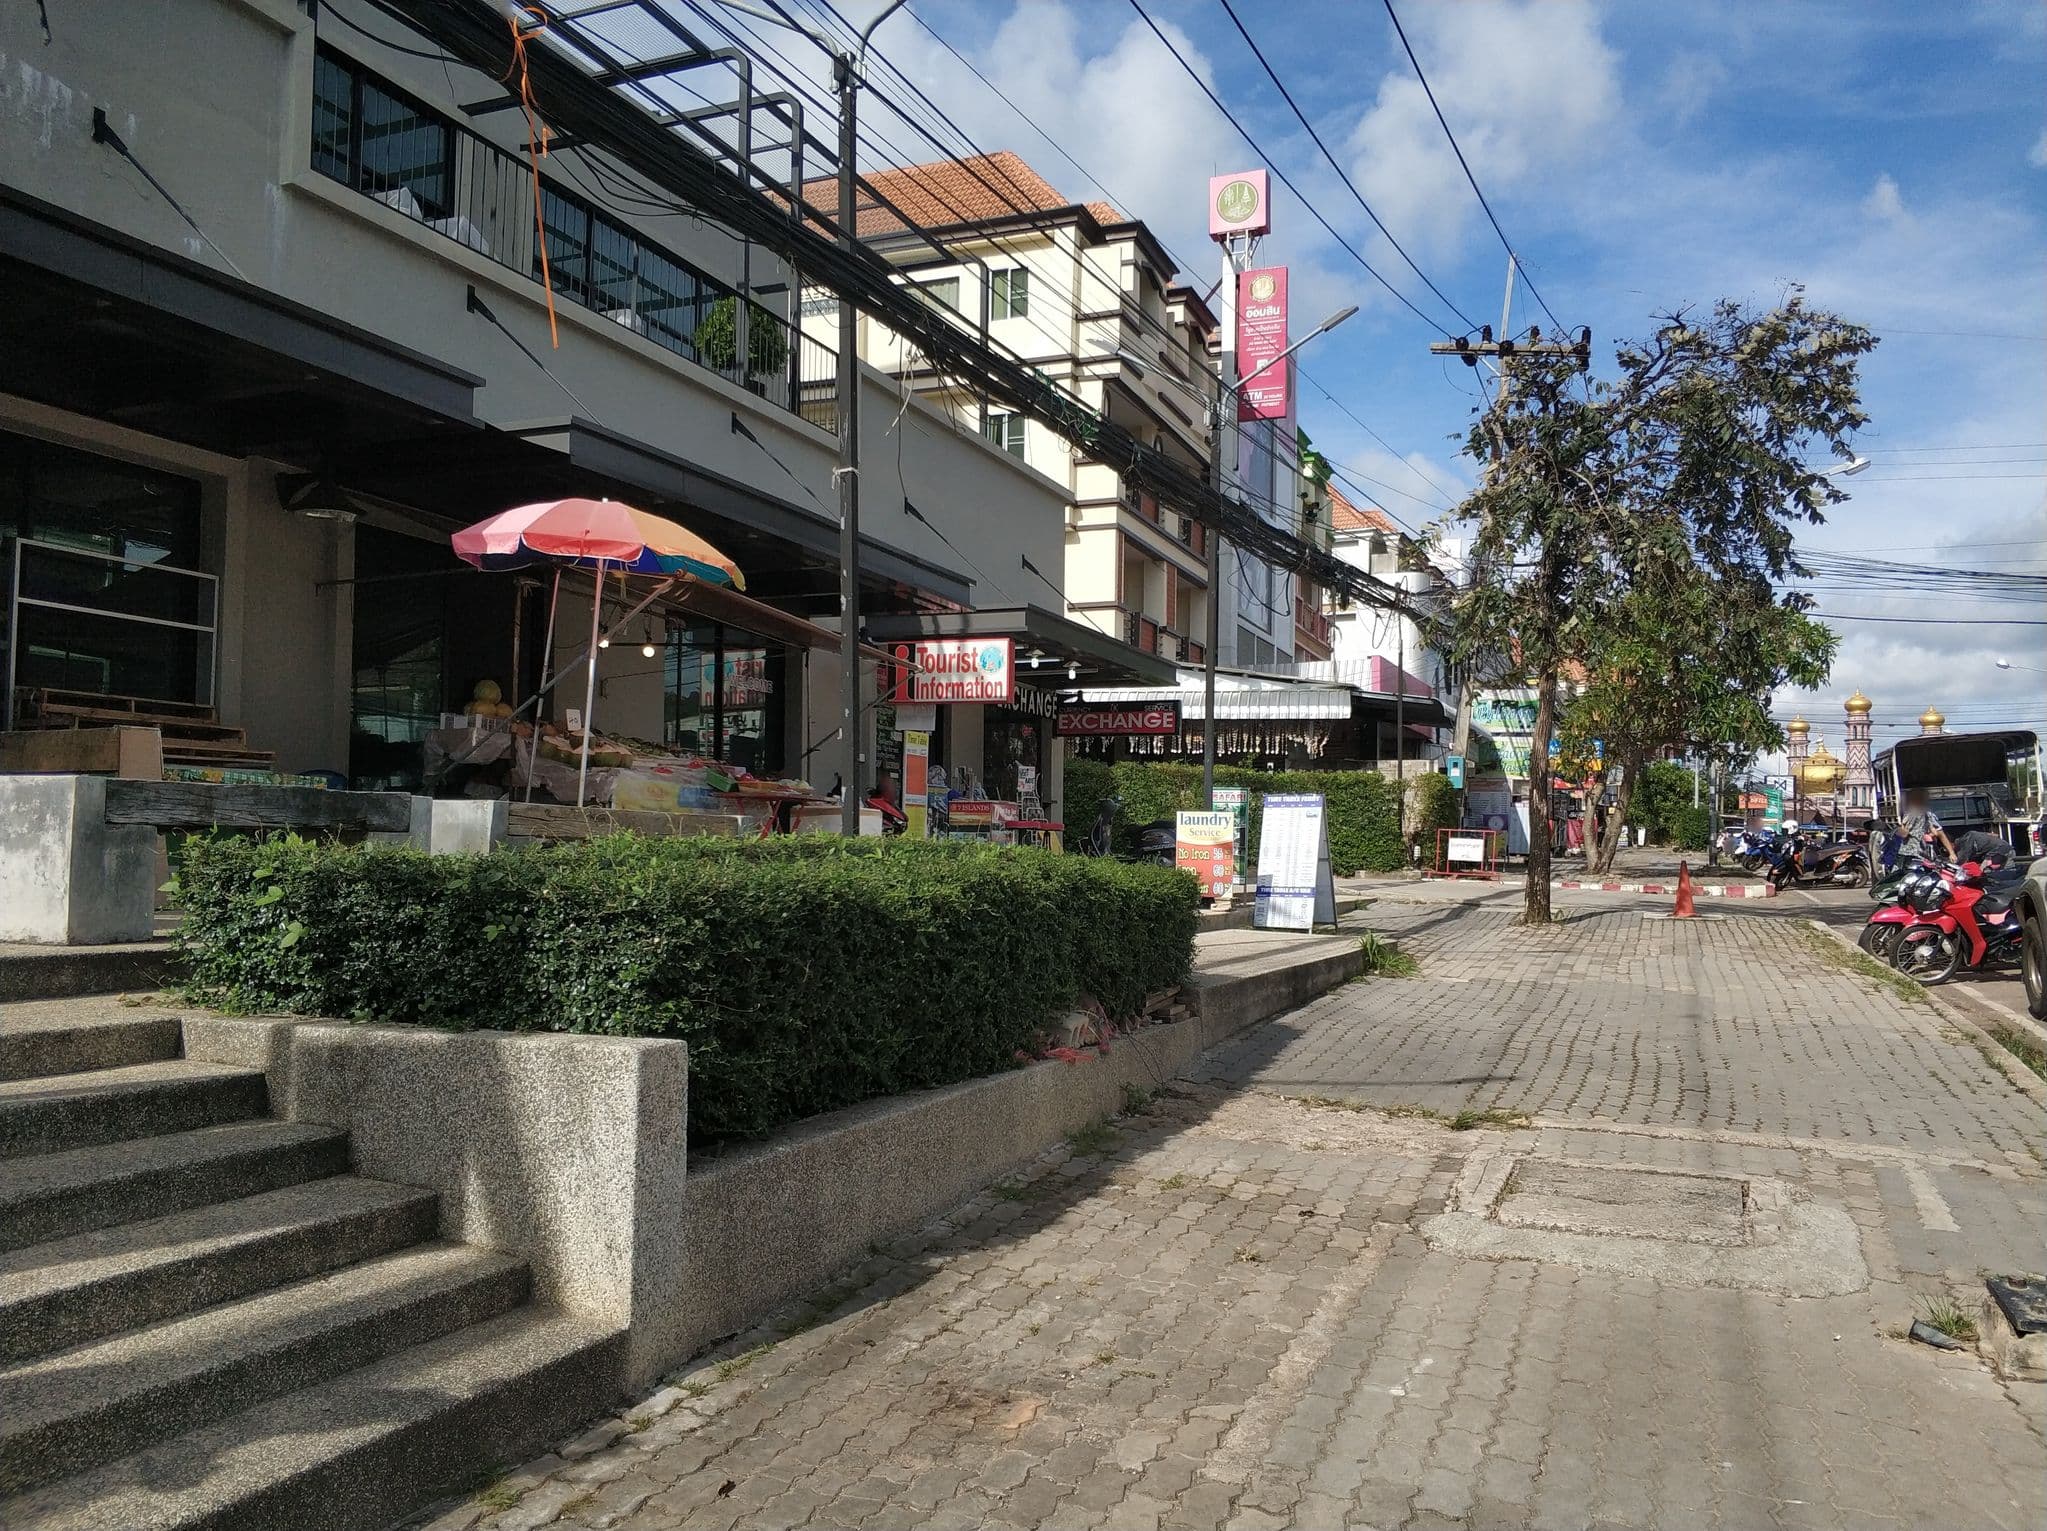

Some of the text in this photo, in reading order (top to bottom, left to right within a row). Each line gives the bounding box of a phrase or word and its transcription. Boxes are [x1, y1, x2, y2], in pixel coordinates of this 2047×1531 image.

[1243, 391, 1263, 400] ATM
[916, 645, 979, 674] Tourist
[915, 675, 1003, 699] Information
[1144, 703, 1174, 712] SERVICE
[1058, 712, 1174, 730] EXCHANGE
[1213, 791, 1246, 800] SAFARI
[962, 804, 990, 812] ISLANDS
[1180, 812, 1231, 830] laundry
[1189, 827, 1220, 837] Service
[1191, 848, 1210, 860] Iron
